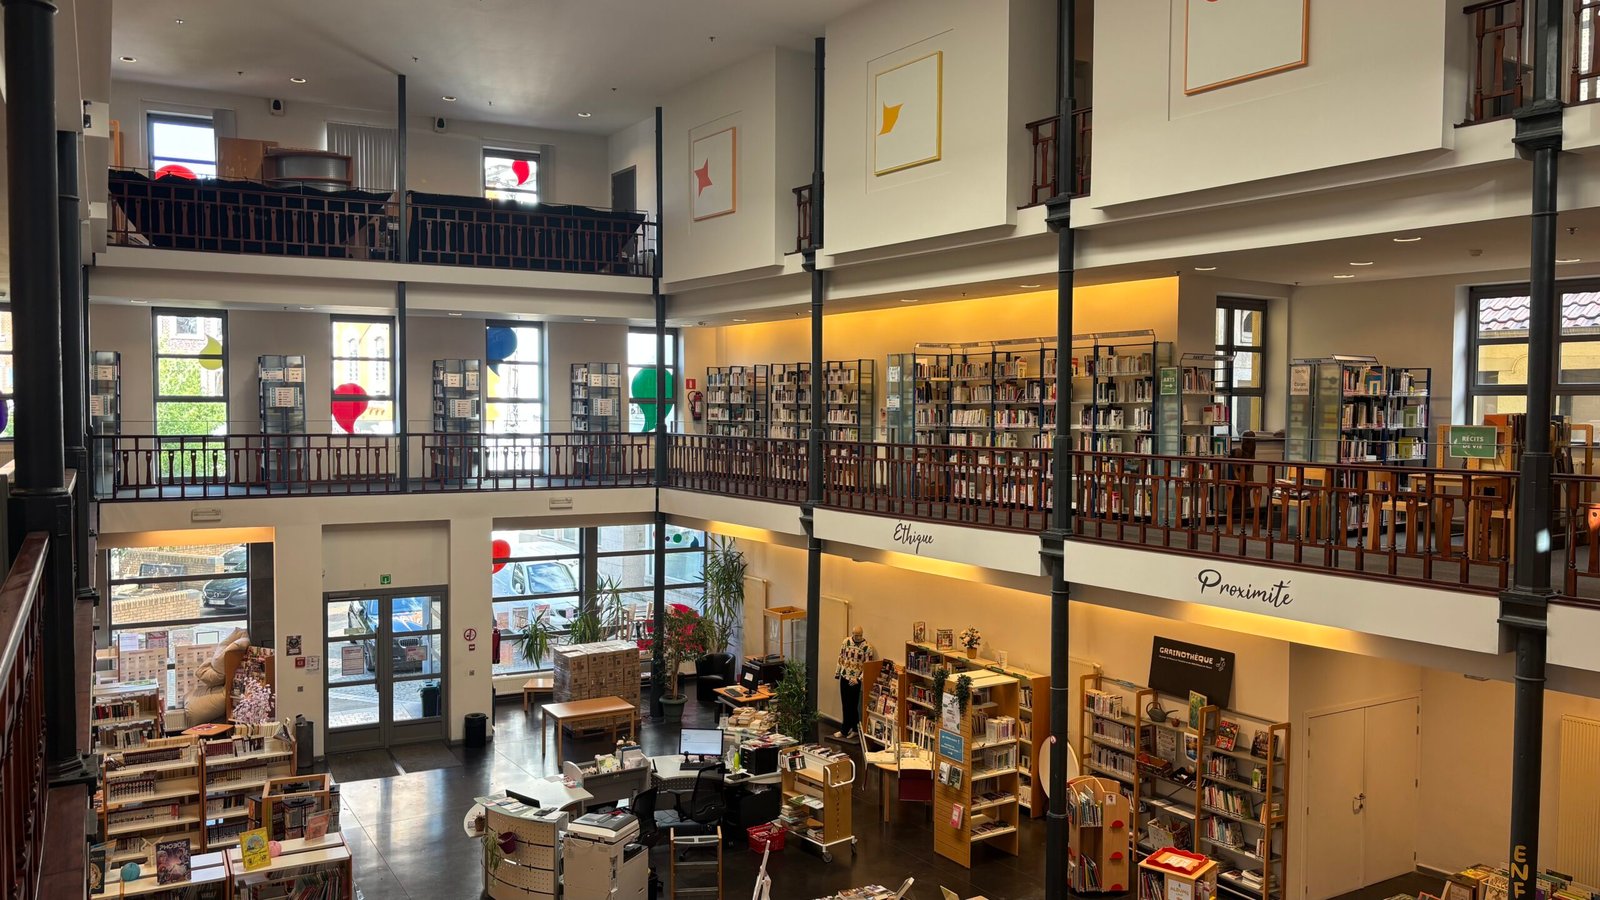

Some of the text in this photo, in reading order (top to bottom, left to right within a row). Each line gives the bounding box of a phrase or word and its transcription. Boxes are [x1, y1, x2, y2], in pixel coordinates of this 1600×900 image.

[893, 519, 935, 555] Éthique
[1197, 568, 1294, 608] Proximité
[1159, 646, 1214, 665] GRAINOTHÈQUE
[159, 841, 188, 851] PHOBOS
